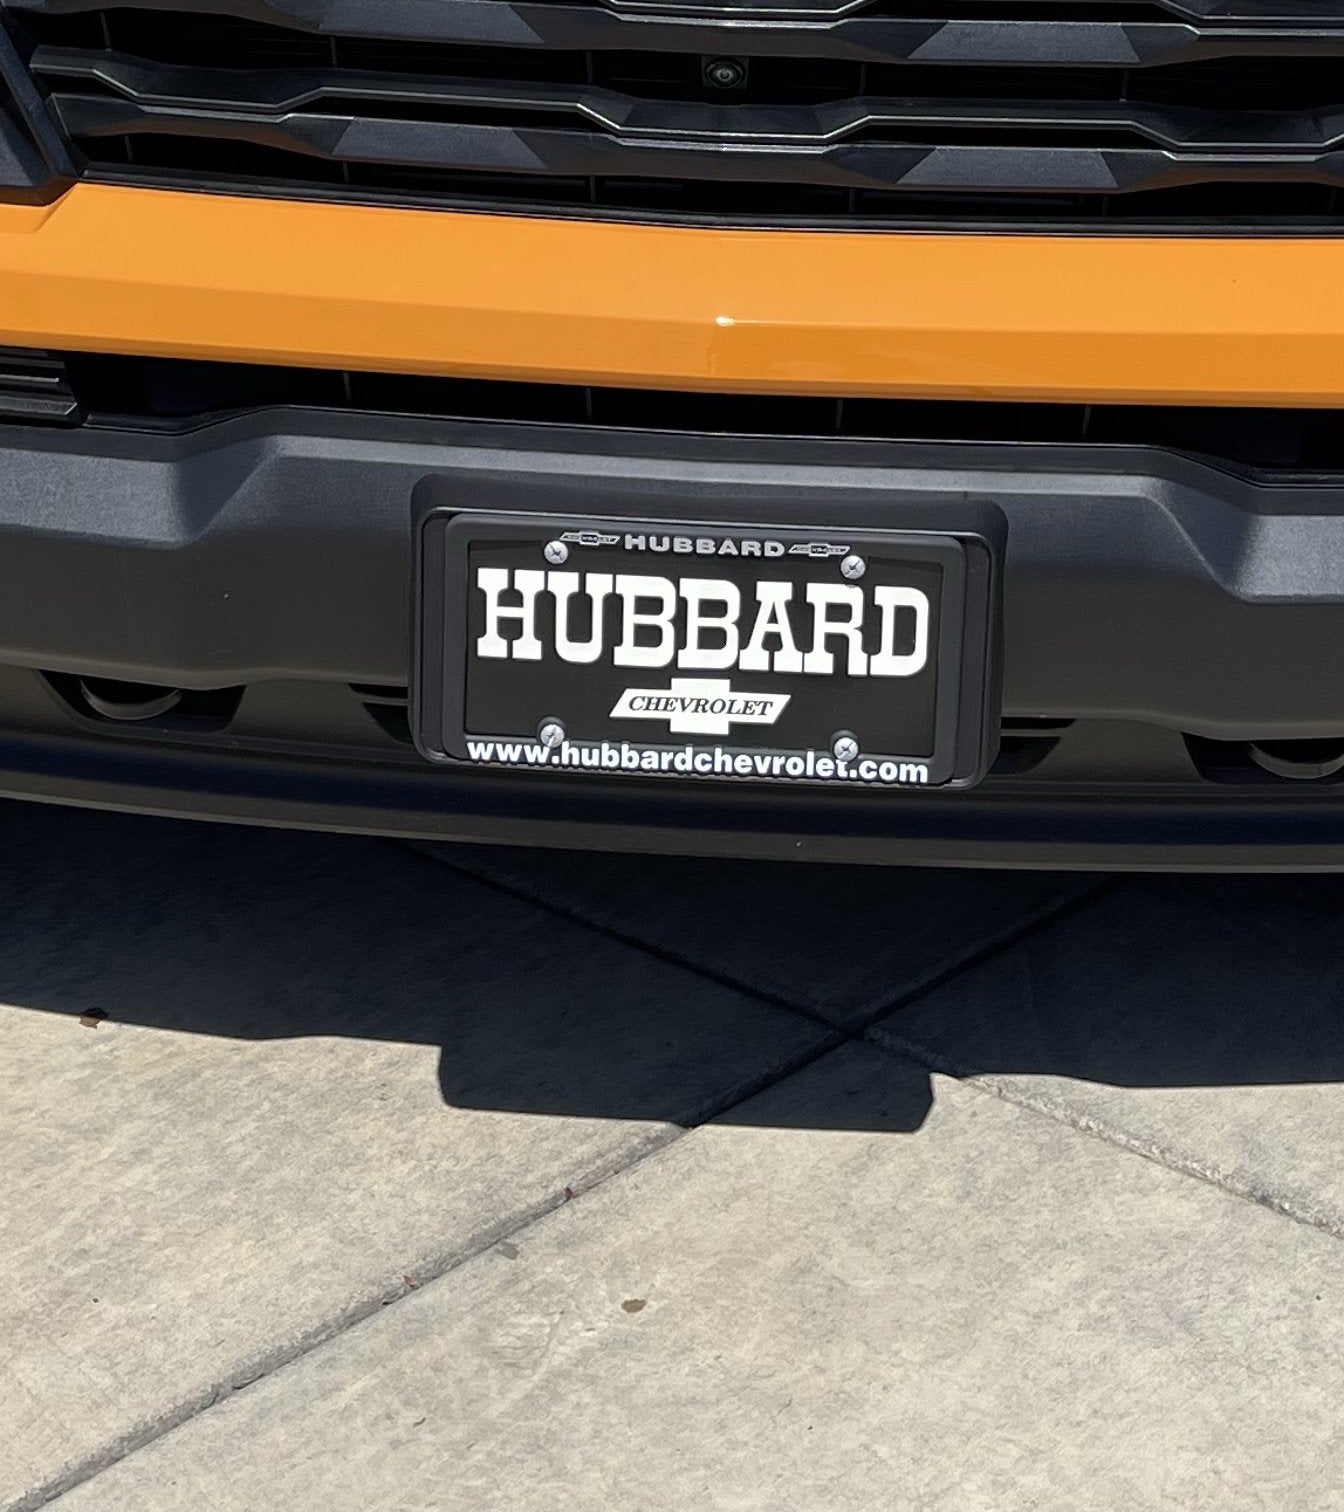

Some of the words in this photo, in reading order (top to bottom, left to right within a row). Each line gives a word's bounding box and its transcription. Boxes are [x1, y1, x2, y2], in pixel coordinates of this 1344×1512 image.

[624, 533, 785, 557] HUBBARD
[476, 567, 930, 676] HUBBARD
[628, 695, 774, 716] CHEVROLET
[467, 739, 928, 783] www.hubbardchevrolet.com
